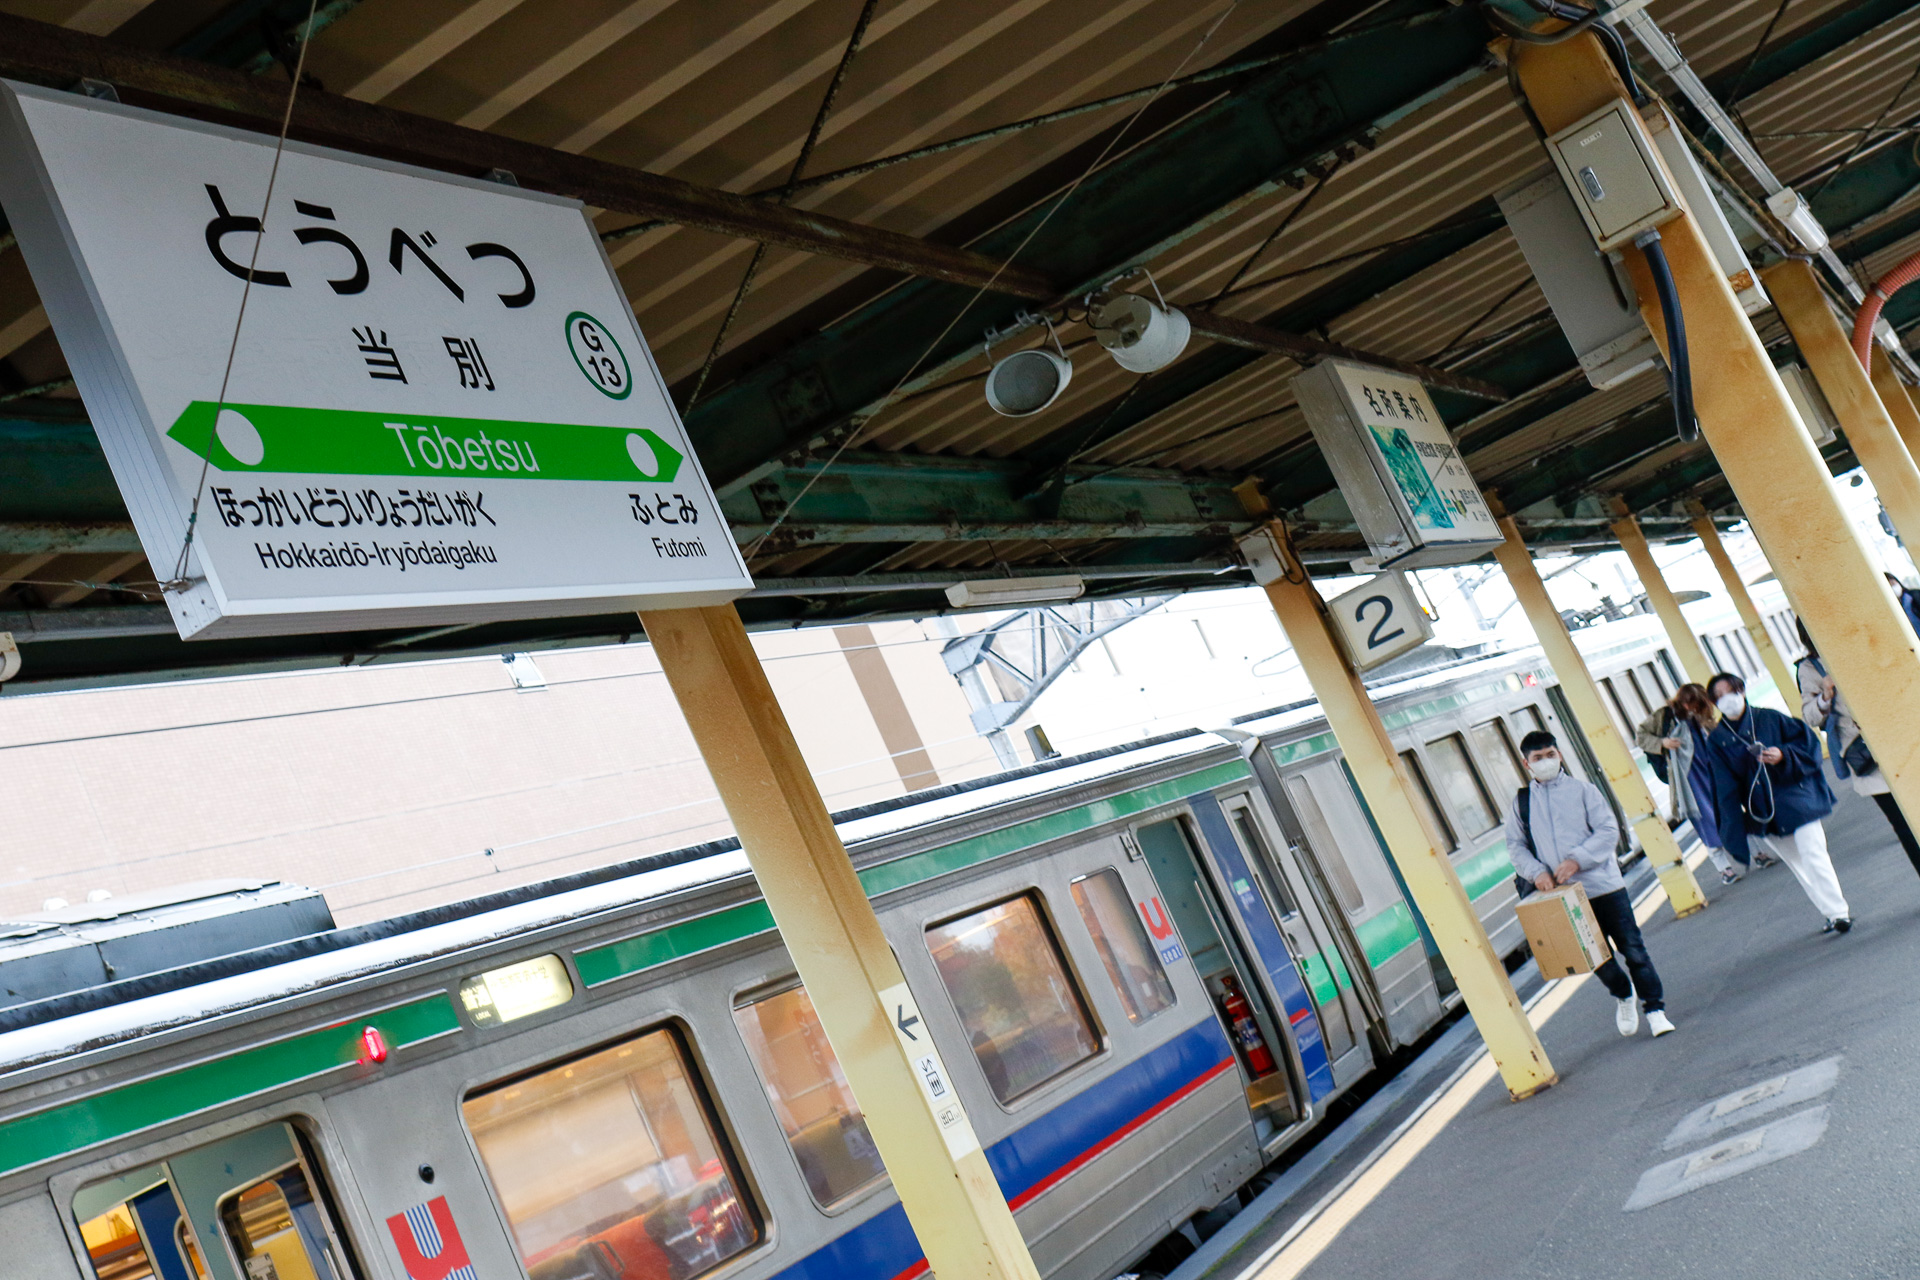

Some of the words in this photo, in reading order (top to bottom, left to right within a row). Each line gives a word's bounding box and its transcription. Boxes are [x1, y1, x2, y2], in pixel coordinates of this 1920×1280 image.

[204, 183, 536, 309] とうべつ
[578, 320, 602, 353] G
[352, 326, 495, 391] 当別
[587, 355, 622, 388] 13
[1362, 384, 1428, 423] 名所案内
[384, 422, 541, 473] Tōbetsu
[210, 486, 497, 528] ほっかいどういりょうだいがく
[629, 492, 699, 526] ふとみ
[255, 540, 498, 572] Hokkaidō-Iryōdaigaku
[652, 536, 707, 558] Futomi
[1355, 595, 1405, 650] 2
